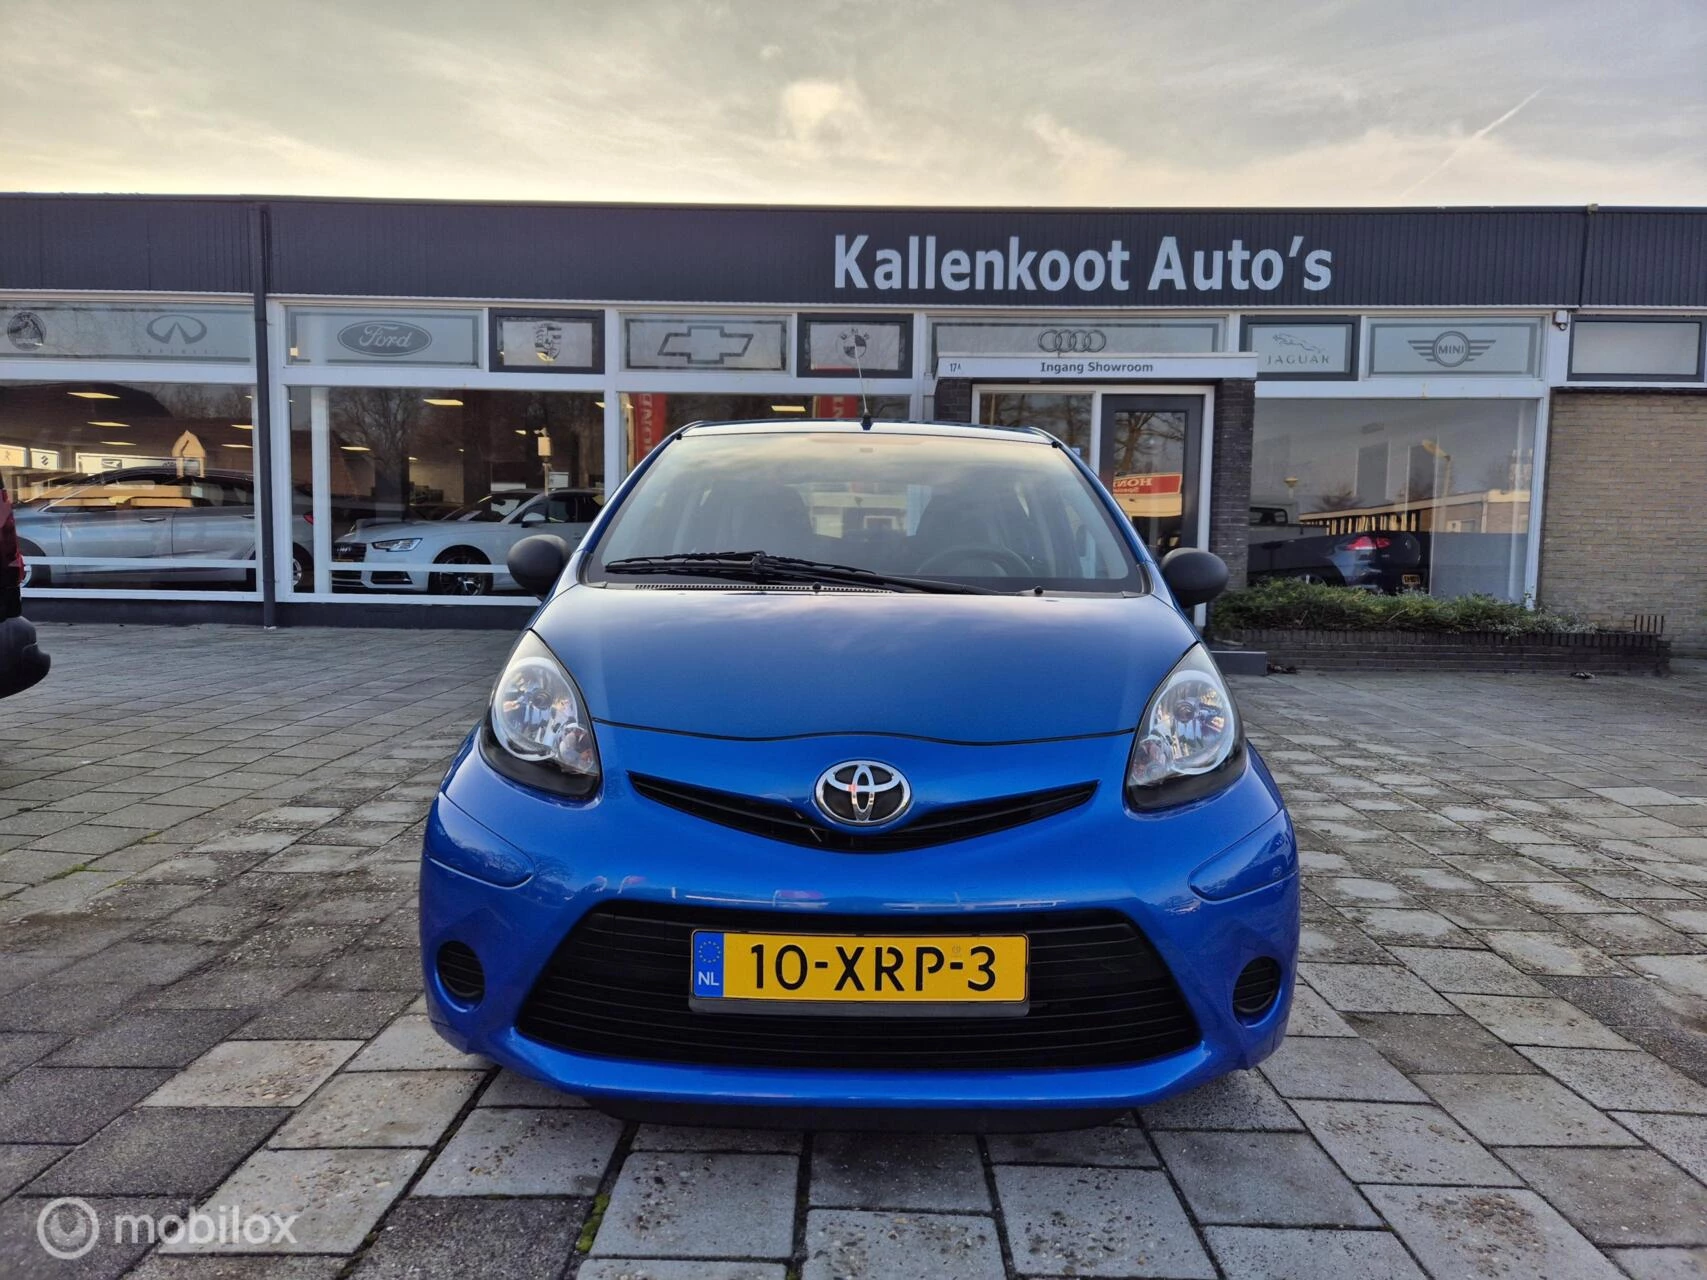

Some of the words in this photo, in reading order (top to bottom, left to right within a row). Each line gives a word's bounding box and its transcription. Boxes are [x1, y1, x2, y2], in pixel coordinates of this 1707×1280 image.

[834, 235, 1130, 291] Kallenkoot
[1148, 235, 1333, 291] Auto's
[359, 325, 413, 348] Ford
[1438, 344, 1466, 355] MINI
[1267, 355, 1330, 365] JAGUAR
[1041, 362, 1084, 375] Ingang
[1088, 362, 1154, 373] Showroom
[750, 944, 997, 992] 10-XRP-3
[698, 971, 720, 986] NL
